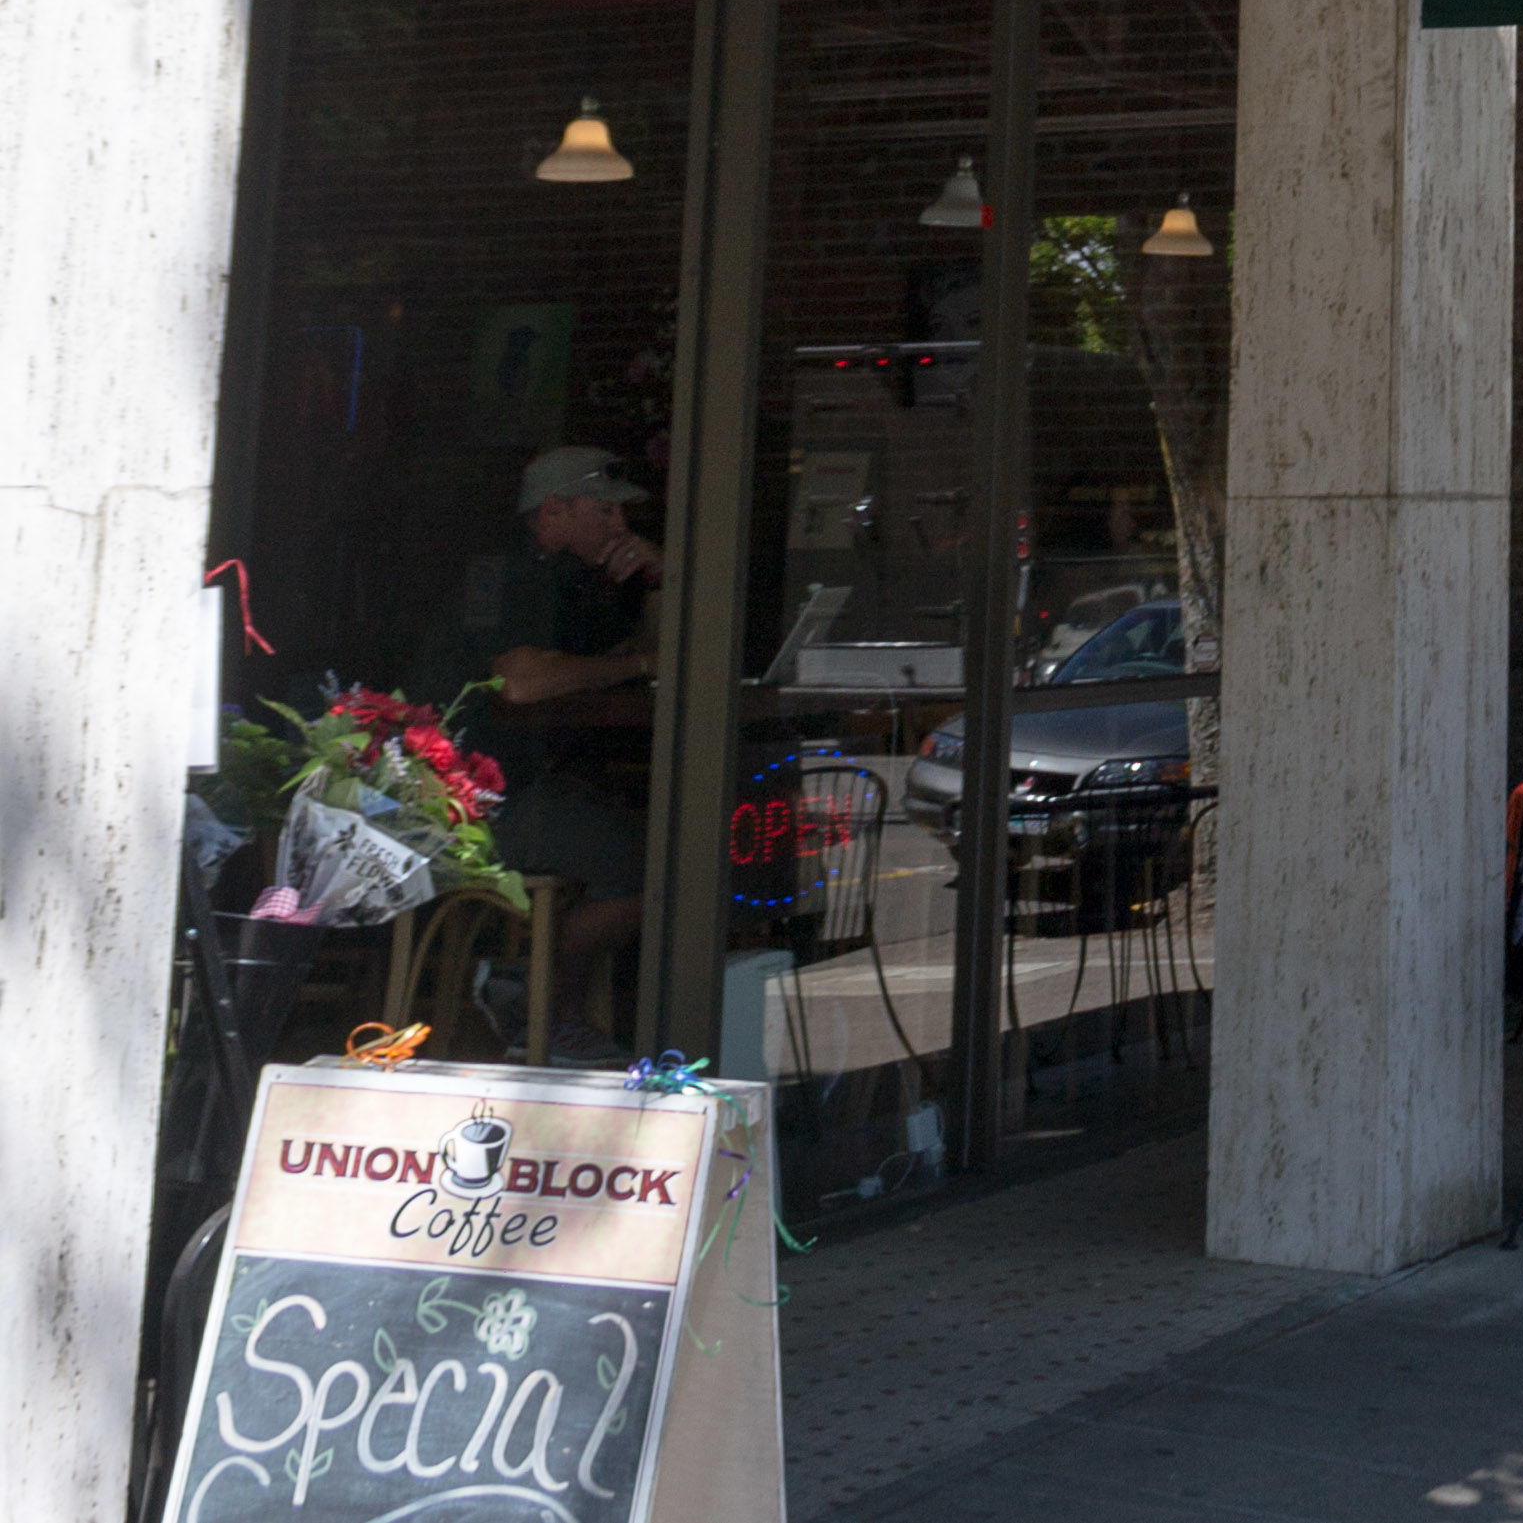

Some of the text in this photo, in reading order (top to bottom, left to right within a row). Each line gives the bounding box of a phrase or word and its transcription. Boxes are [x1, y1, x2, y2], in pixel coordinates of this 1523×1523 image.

[729, 793, 853, 865] OPEN
[279, 1139, 681, 1206] UNION BLOCK
[389, 1188, 558, 1258] Coffee
[215, 1294, 639, 1507] Special
